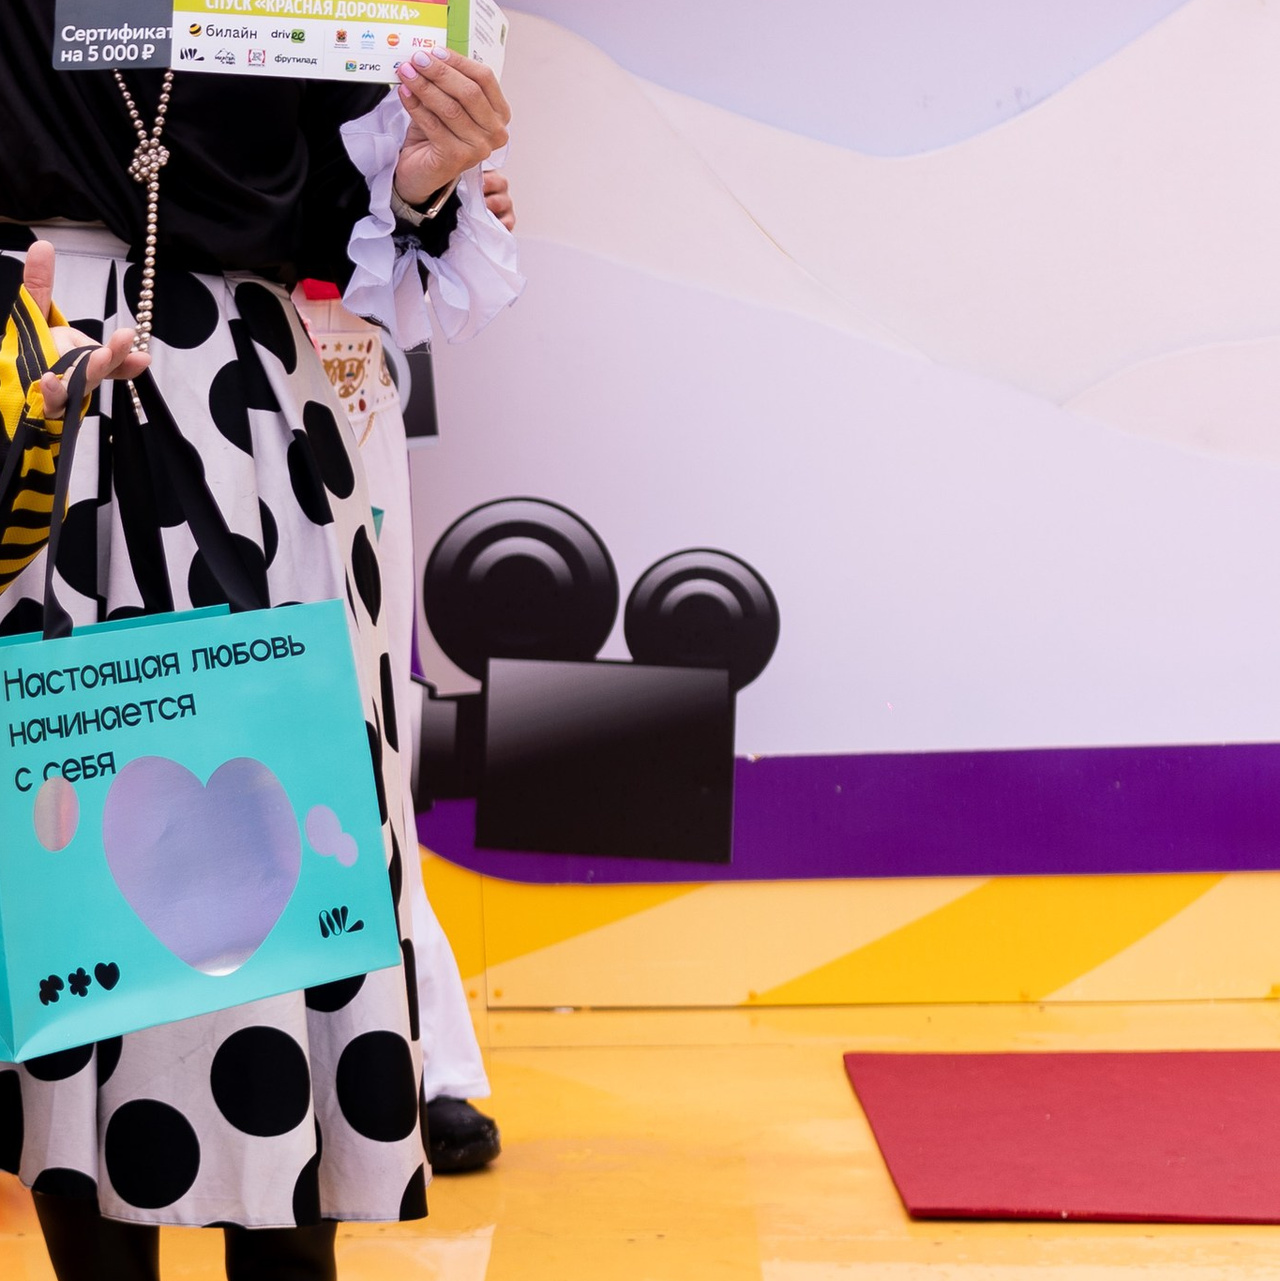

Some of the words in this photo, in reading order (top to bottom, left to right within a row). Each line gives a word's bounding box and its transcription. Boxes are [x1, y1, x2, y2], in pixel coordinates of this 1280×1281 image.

[335, 0, 420, 20] ДОРОЖКА»
[206, 24, 258, 39] билайн
[271, 29, 306, 42] drivee
[60, 50, 83, 62] на
[359, 63, 382, 72] 2ГИС
[3, 651, 181, 702] Настоящая
[192, 634, 306, 673] любовь
[8, 693, 197, 748] начинается
[14, 765, 33, 793] с
